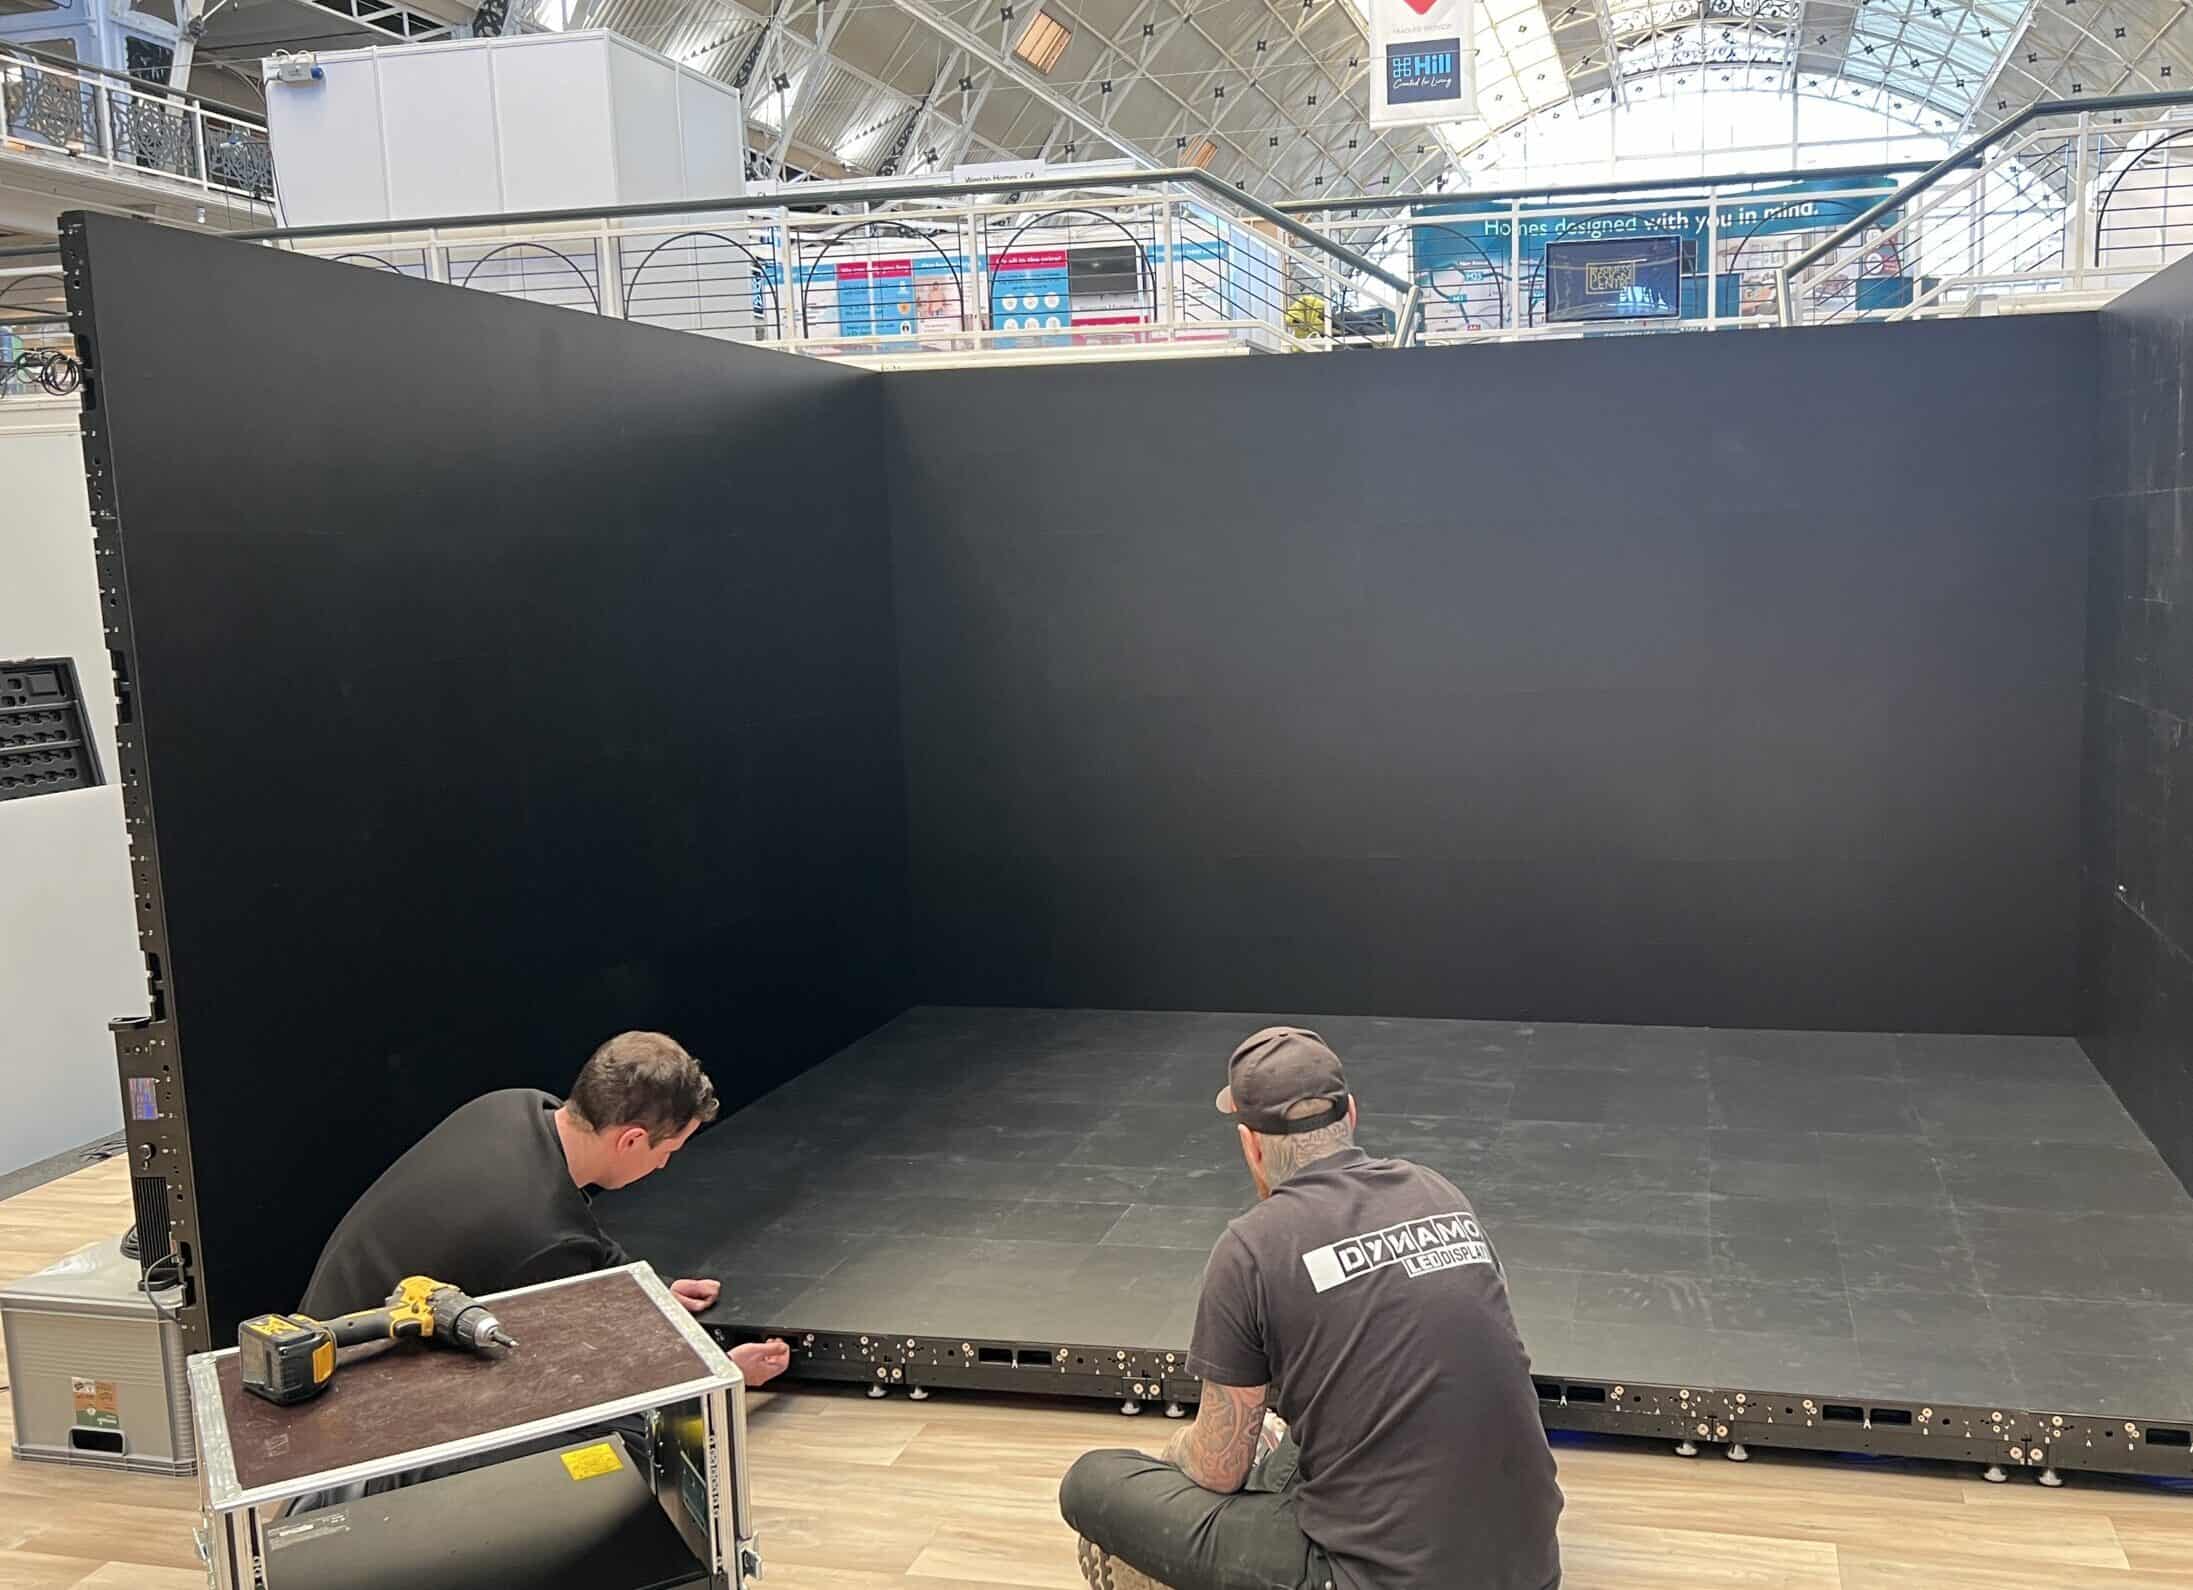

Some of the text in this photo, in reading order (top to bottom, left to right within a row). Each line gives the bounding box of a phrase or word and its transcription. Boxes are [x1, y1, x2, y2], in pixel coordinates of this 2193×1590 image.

[1414, 53, 1451, 76] Hill
[1555, 217, 1637, 239] designed
[1644, 211, 1689, 231] with
[1739, 207, 1757, 225] in
[1763, 201, 1819, 220] mind.
